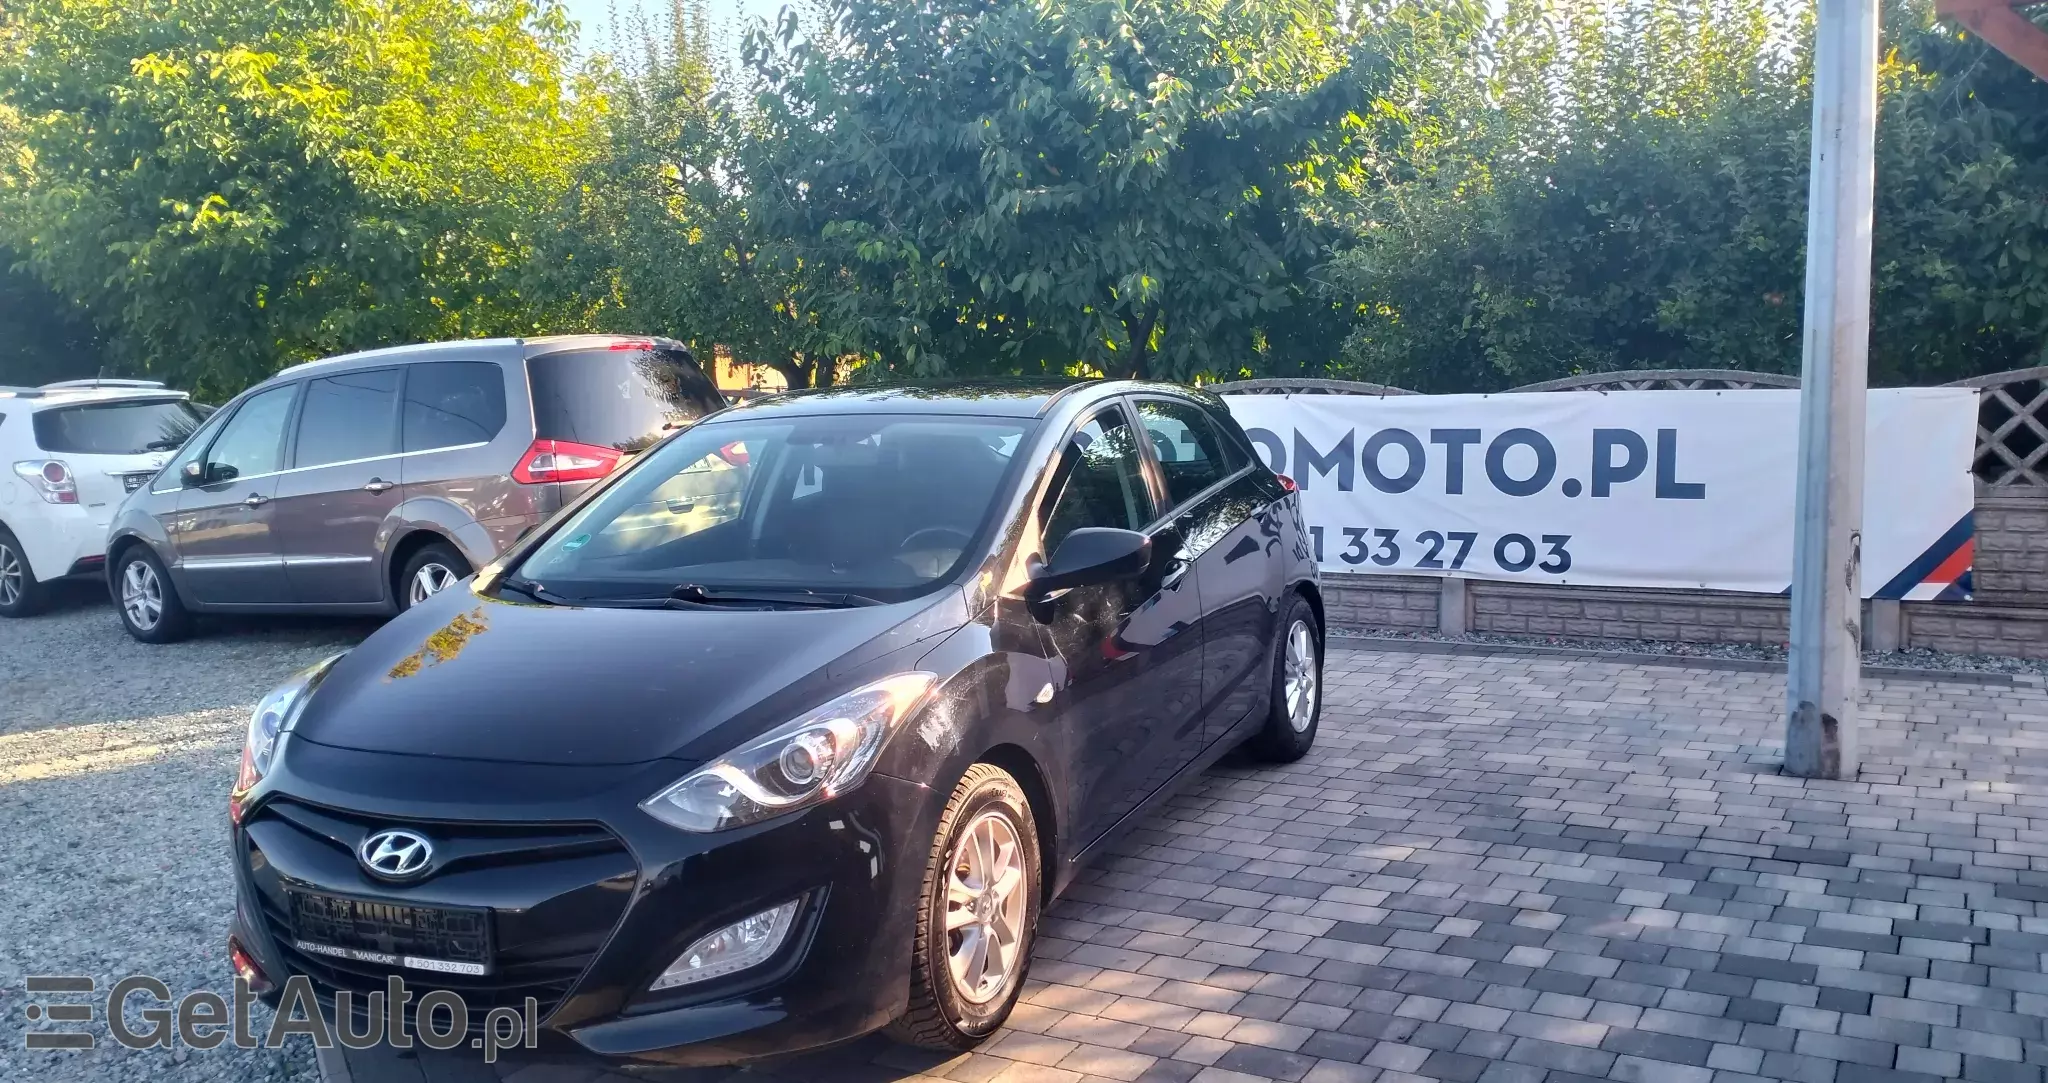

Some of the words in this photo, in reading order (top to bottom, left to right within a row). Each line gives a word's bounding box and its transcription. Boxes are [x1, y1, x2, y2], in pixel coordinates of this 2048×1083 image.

[1340, 527, 1401, 566] 33
[1415, 530, 1478, 570] 27
[1493, 533, 1572, 574] 03
[296, 940, 347, 957] AUTO-HANDEL
